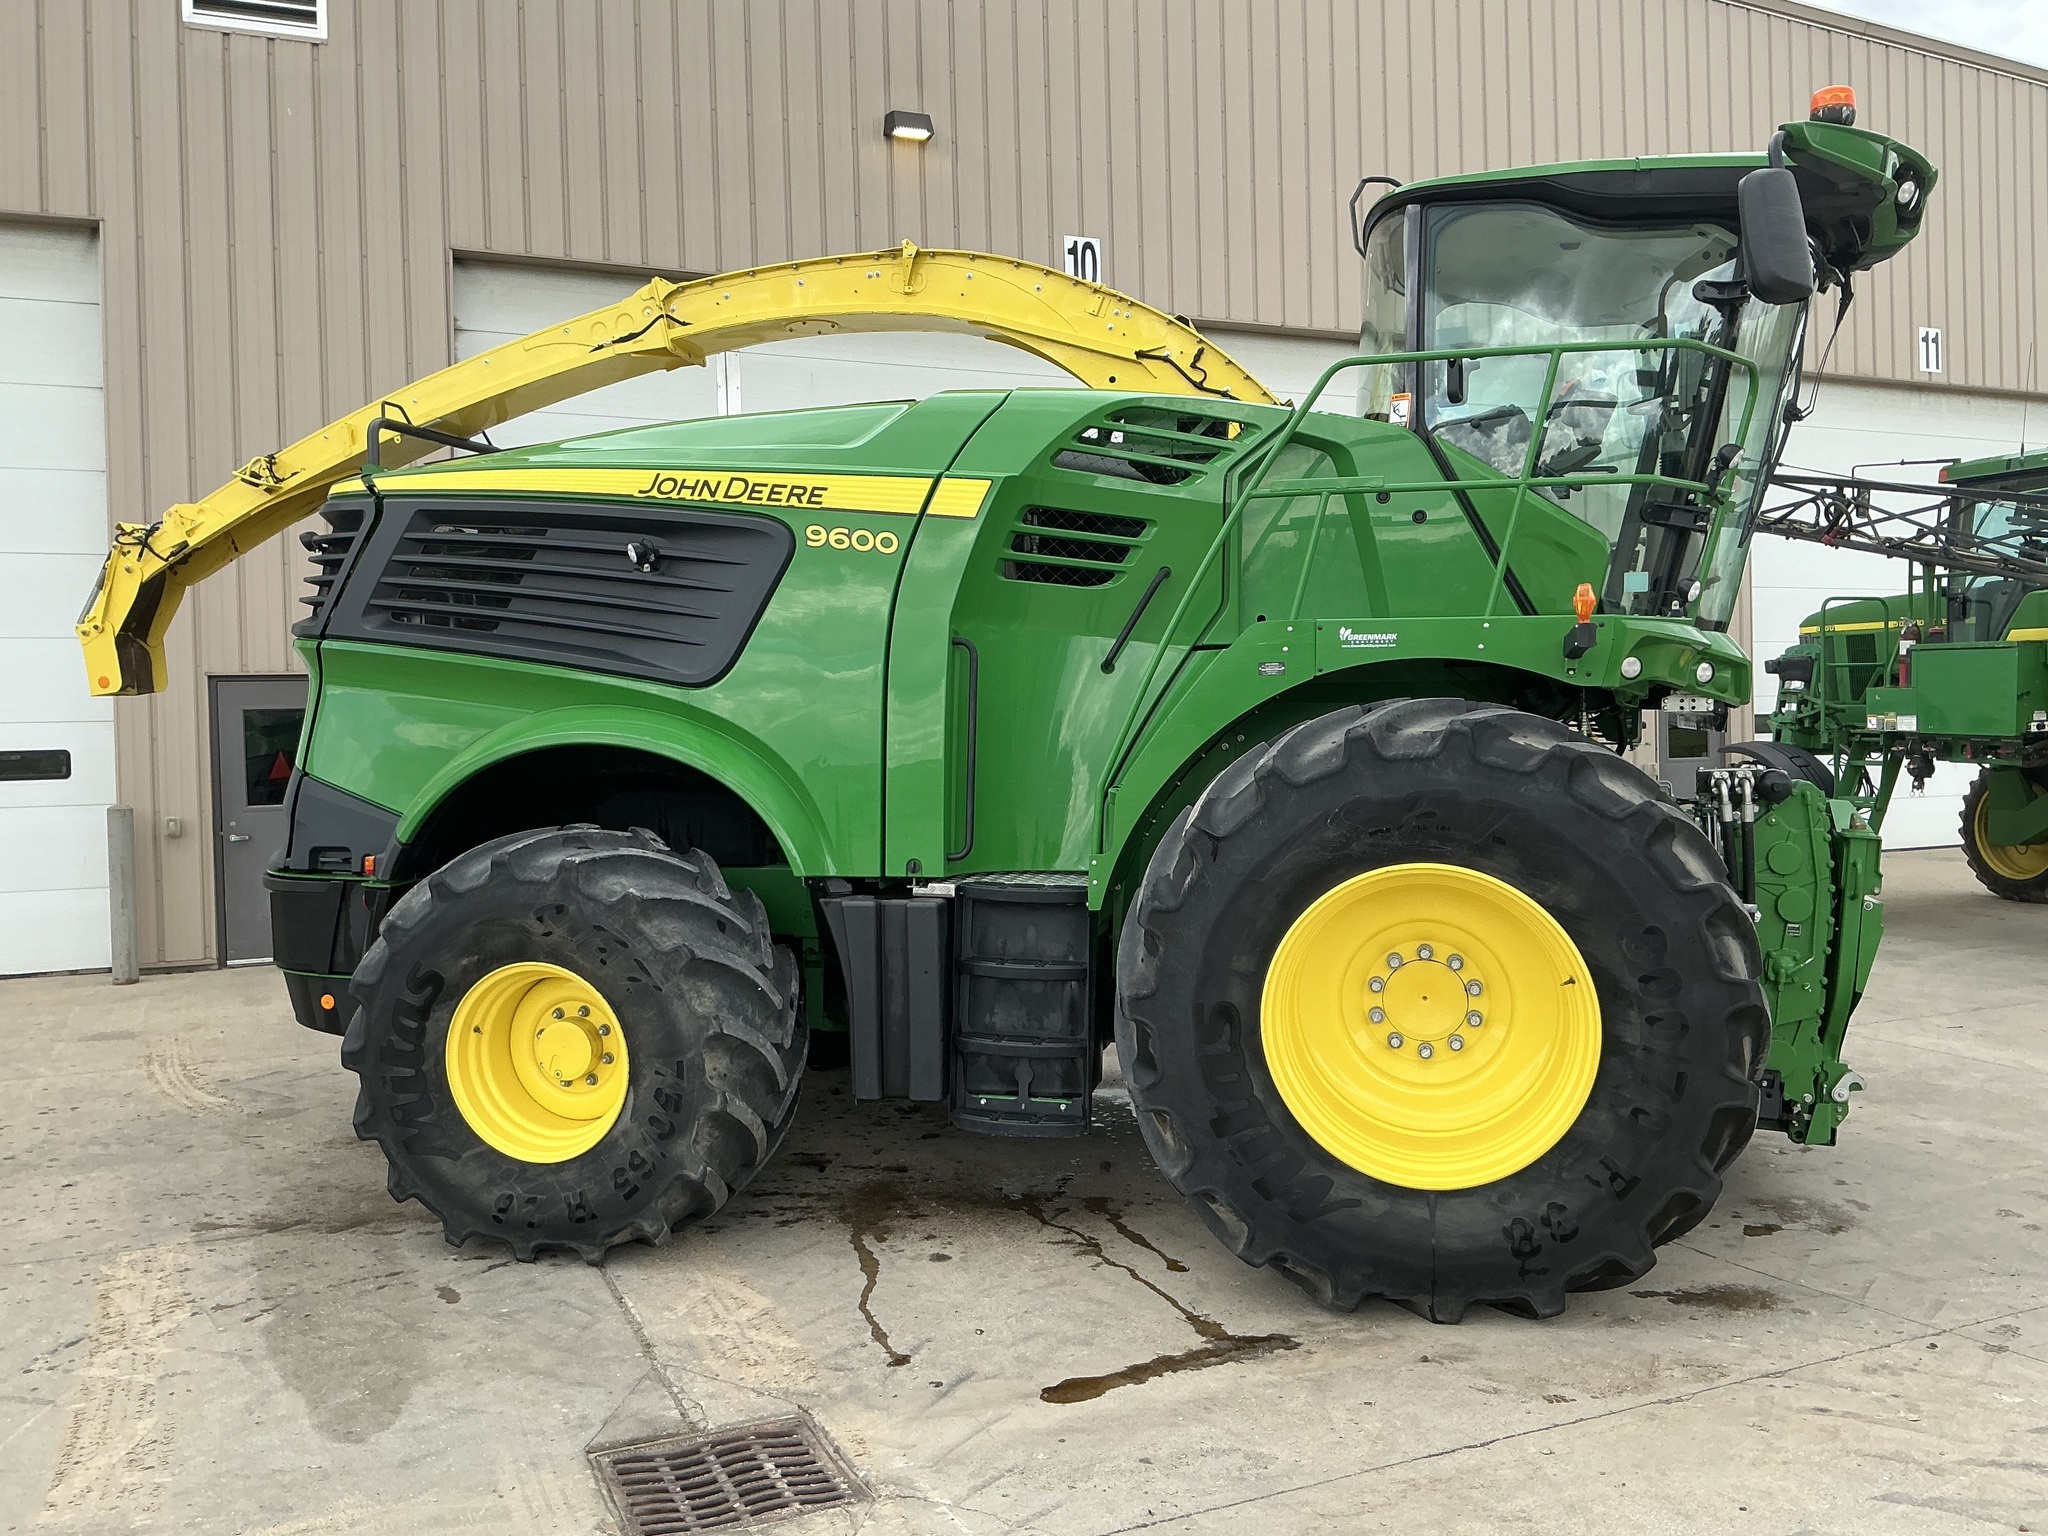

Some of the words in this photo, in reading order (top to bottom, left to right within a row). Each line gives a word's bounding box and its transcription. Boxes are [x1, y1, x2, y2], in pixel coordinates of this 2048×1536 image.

[1067, 240, 1097, 282] 10
[1921, 330, 1940, 370] 11
[638, 472, 722, 499] JOHN
[723, 476, 829, 506] DEERE
[804, 523, 900, 555] 9600
[1347, 633, 1398, 641] GREENMARK
[382, 959, 463, 1162] Mitas
[610, 1059, 687, 1202] 750/65
[1194, 1000, 1363, 1225] Mitas
